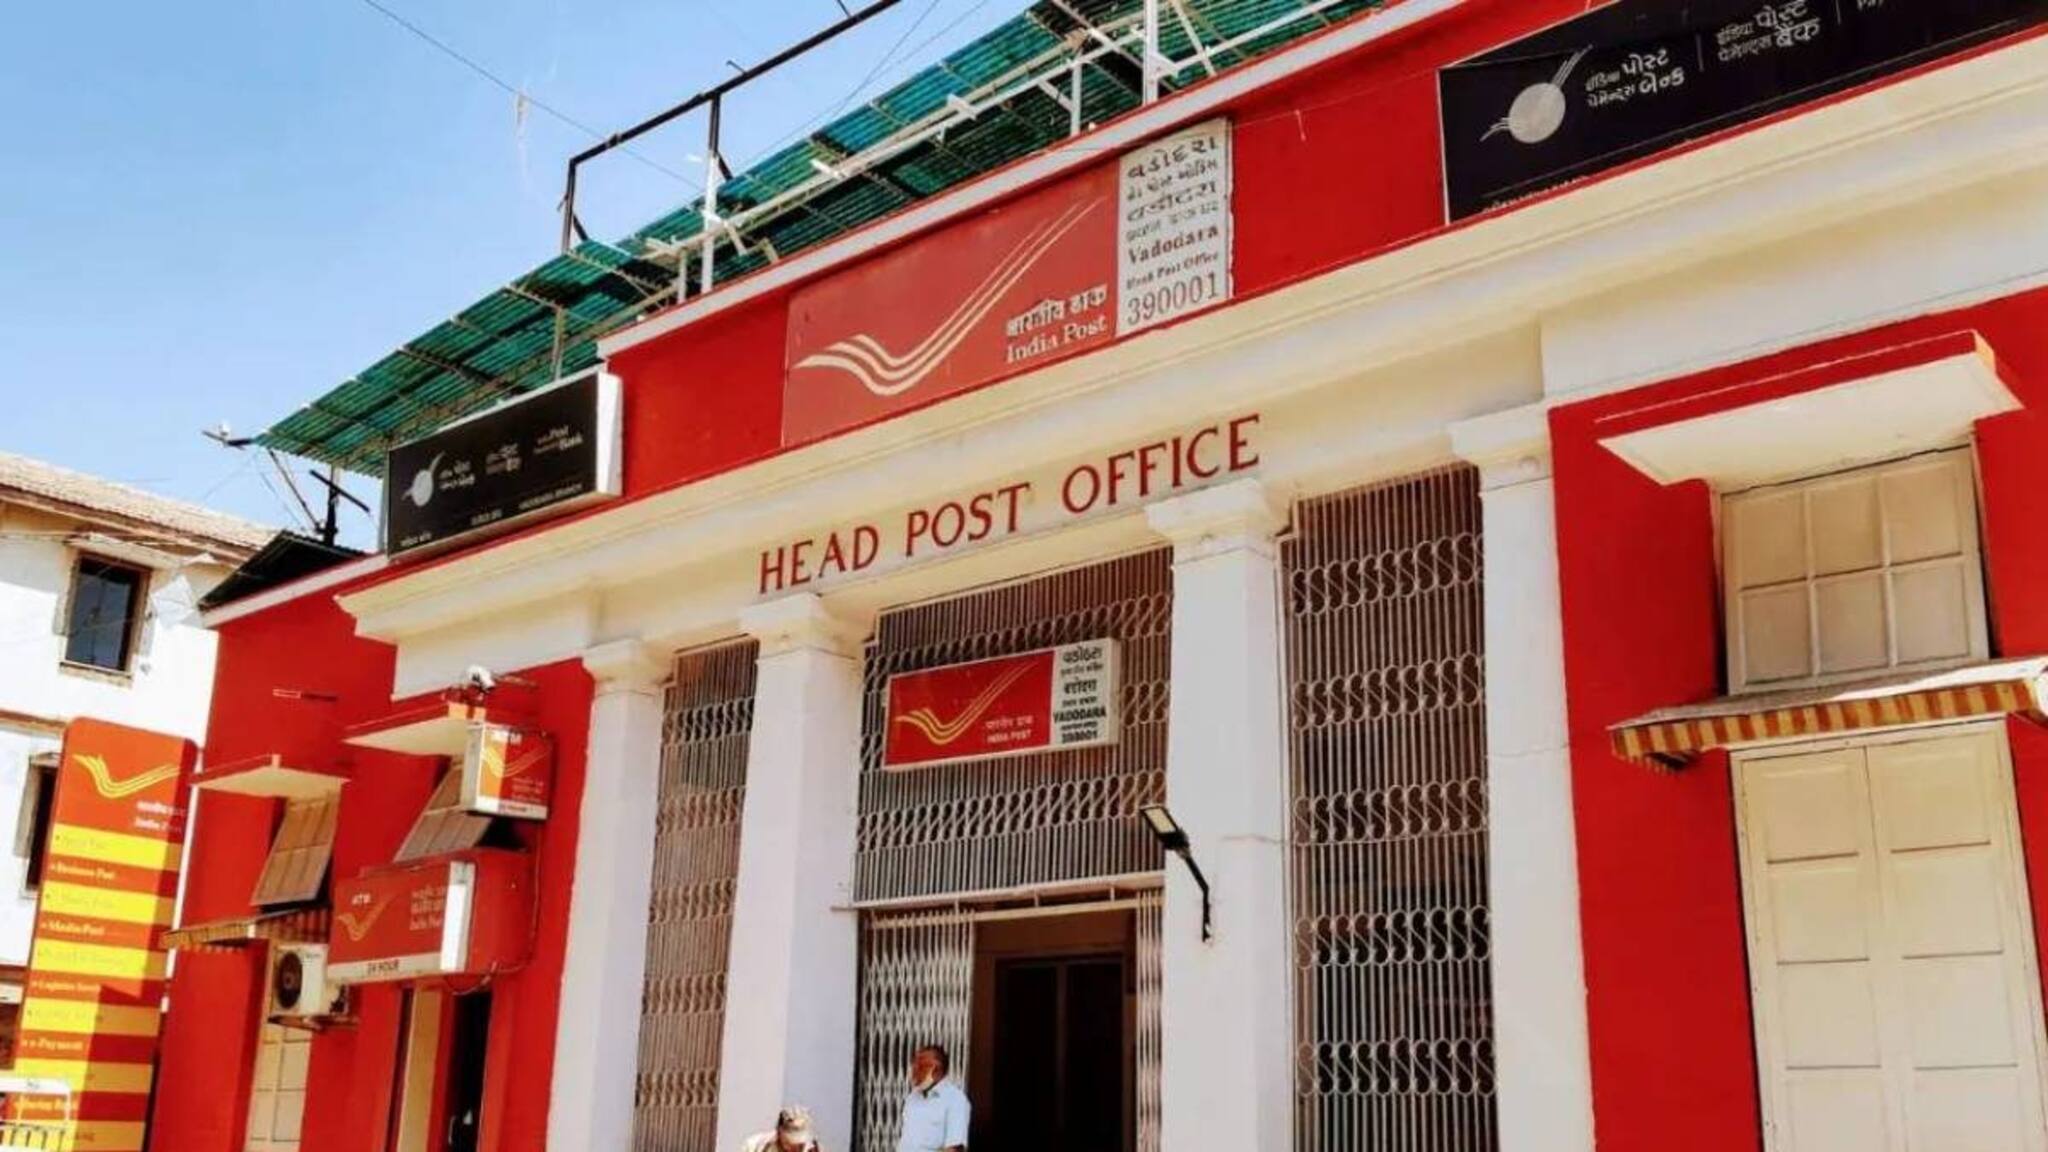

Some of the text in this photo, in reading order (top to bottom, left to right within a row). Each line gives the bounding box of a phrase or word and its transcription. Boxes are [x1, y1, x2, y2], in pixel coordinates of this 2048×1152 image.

[1127, 224, 1219, 265] Vadodara
[1127, 271, 1220, 327] 390001
[1006, 314, 1107, 364] India Post
[759, 413, 1260, 594] HEAD POST OFFICE
[1011, 729, 1032, 741] POST
[1053, 706, 1106, 723] VADODARA
